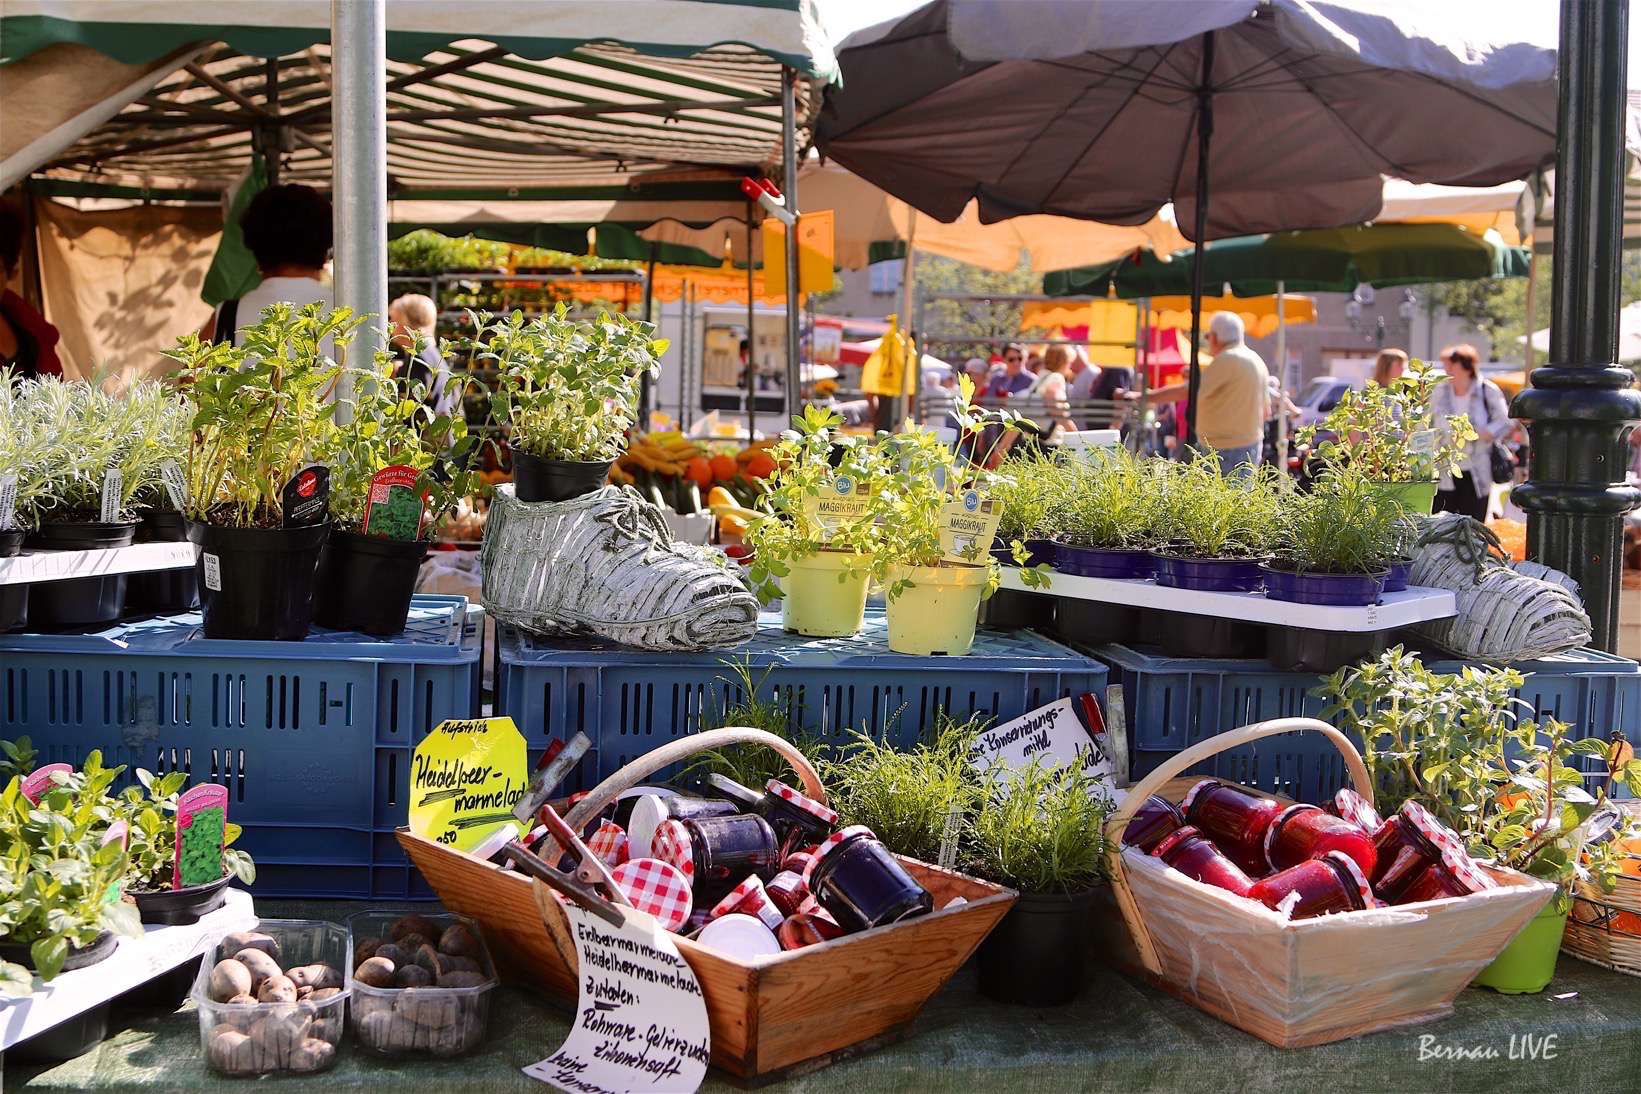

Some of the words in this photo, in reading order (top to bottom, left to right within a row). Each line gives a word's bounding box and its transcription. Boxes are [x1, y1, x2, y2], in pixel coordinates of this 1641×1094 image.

[837, 481, 850, 490] Blu
[967, 497, 977, 506] Blu
[819, 502, 865, 514] MAGGIKRAUT
[950, 518, 987, 533] MAGGIKRAUT
